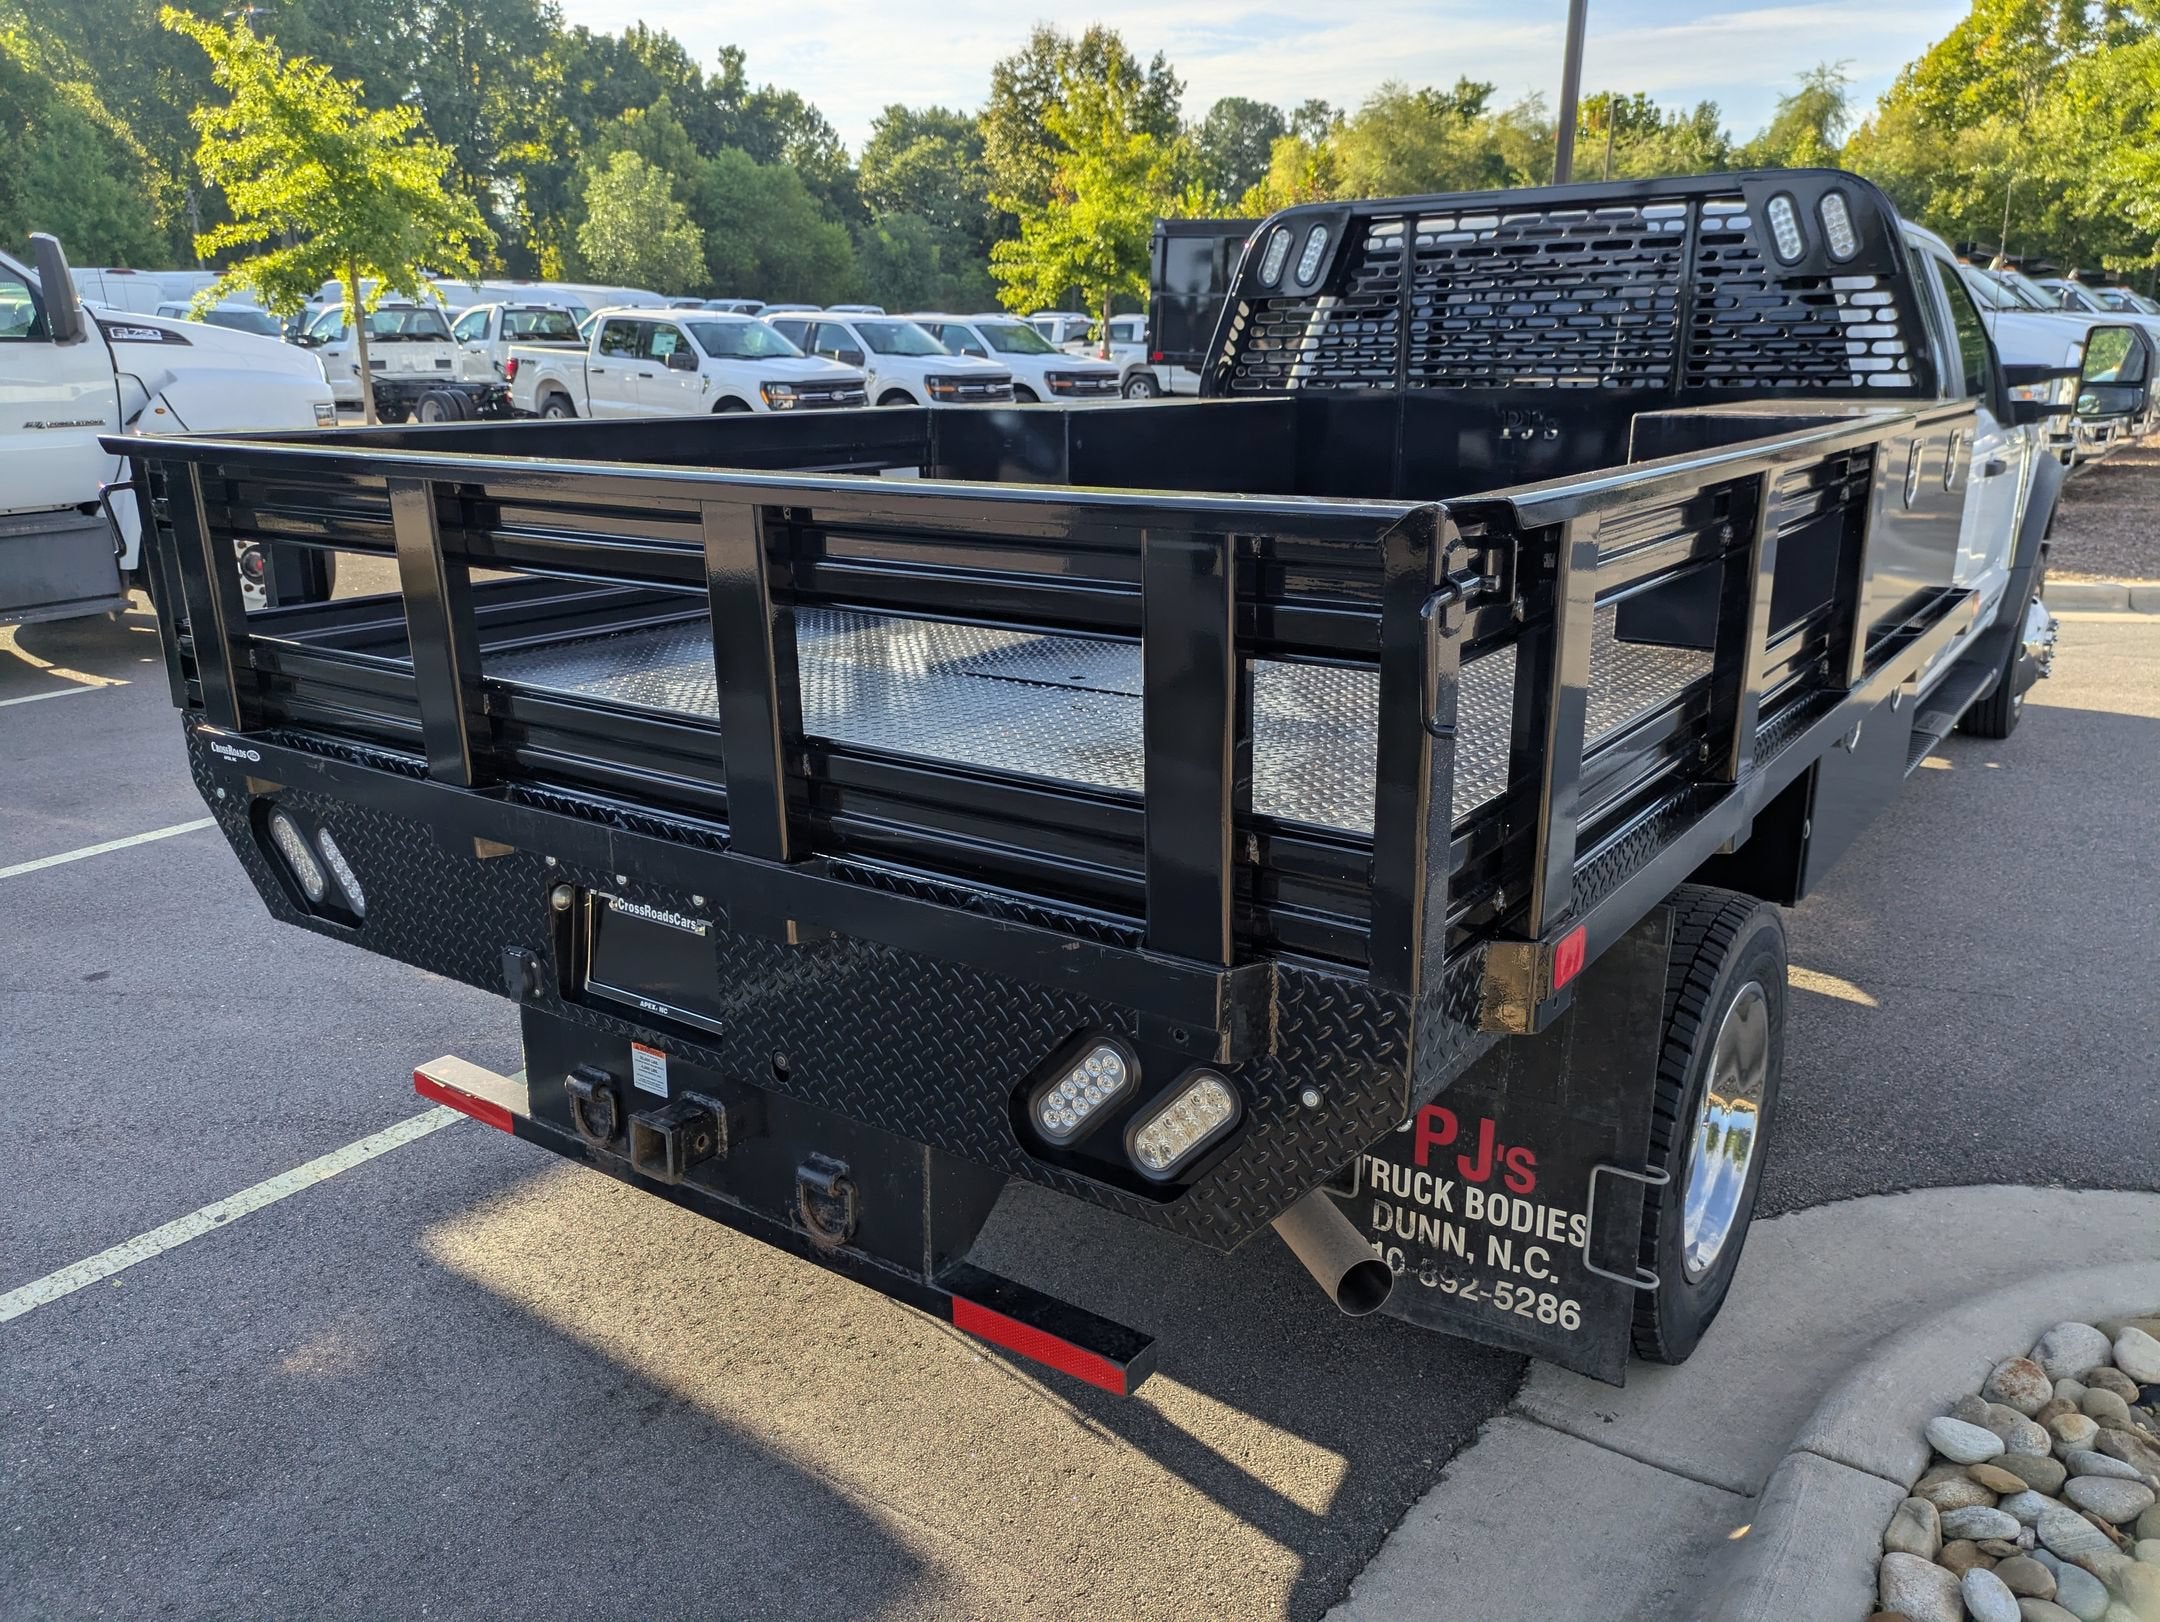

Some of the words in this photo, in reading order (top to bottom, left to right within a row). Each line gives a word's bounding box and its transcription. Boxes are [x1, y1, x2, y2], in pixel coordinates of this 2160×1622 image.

[640, 1001, 658, 1011] APEX,
[659, 1006, 669, 1015] NC
[1372, 1198, 1475, 1265] DUNN,
[1487, 1234, 1560, 1284] N.C.
[1465, 1186, 1587, 1248] BODIES
